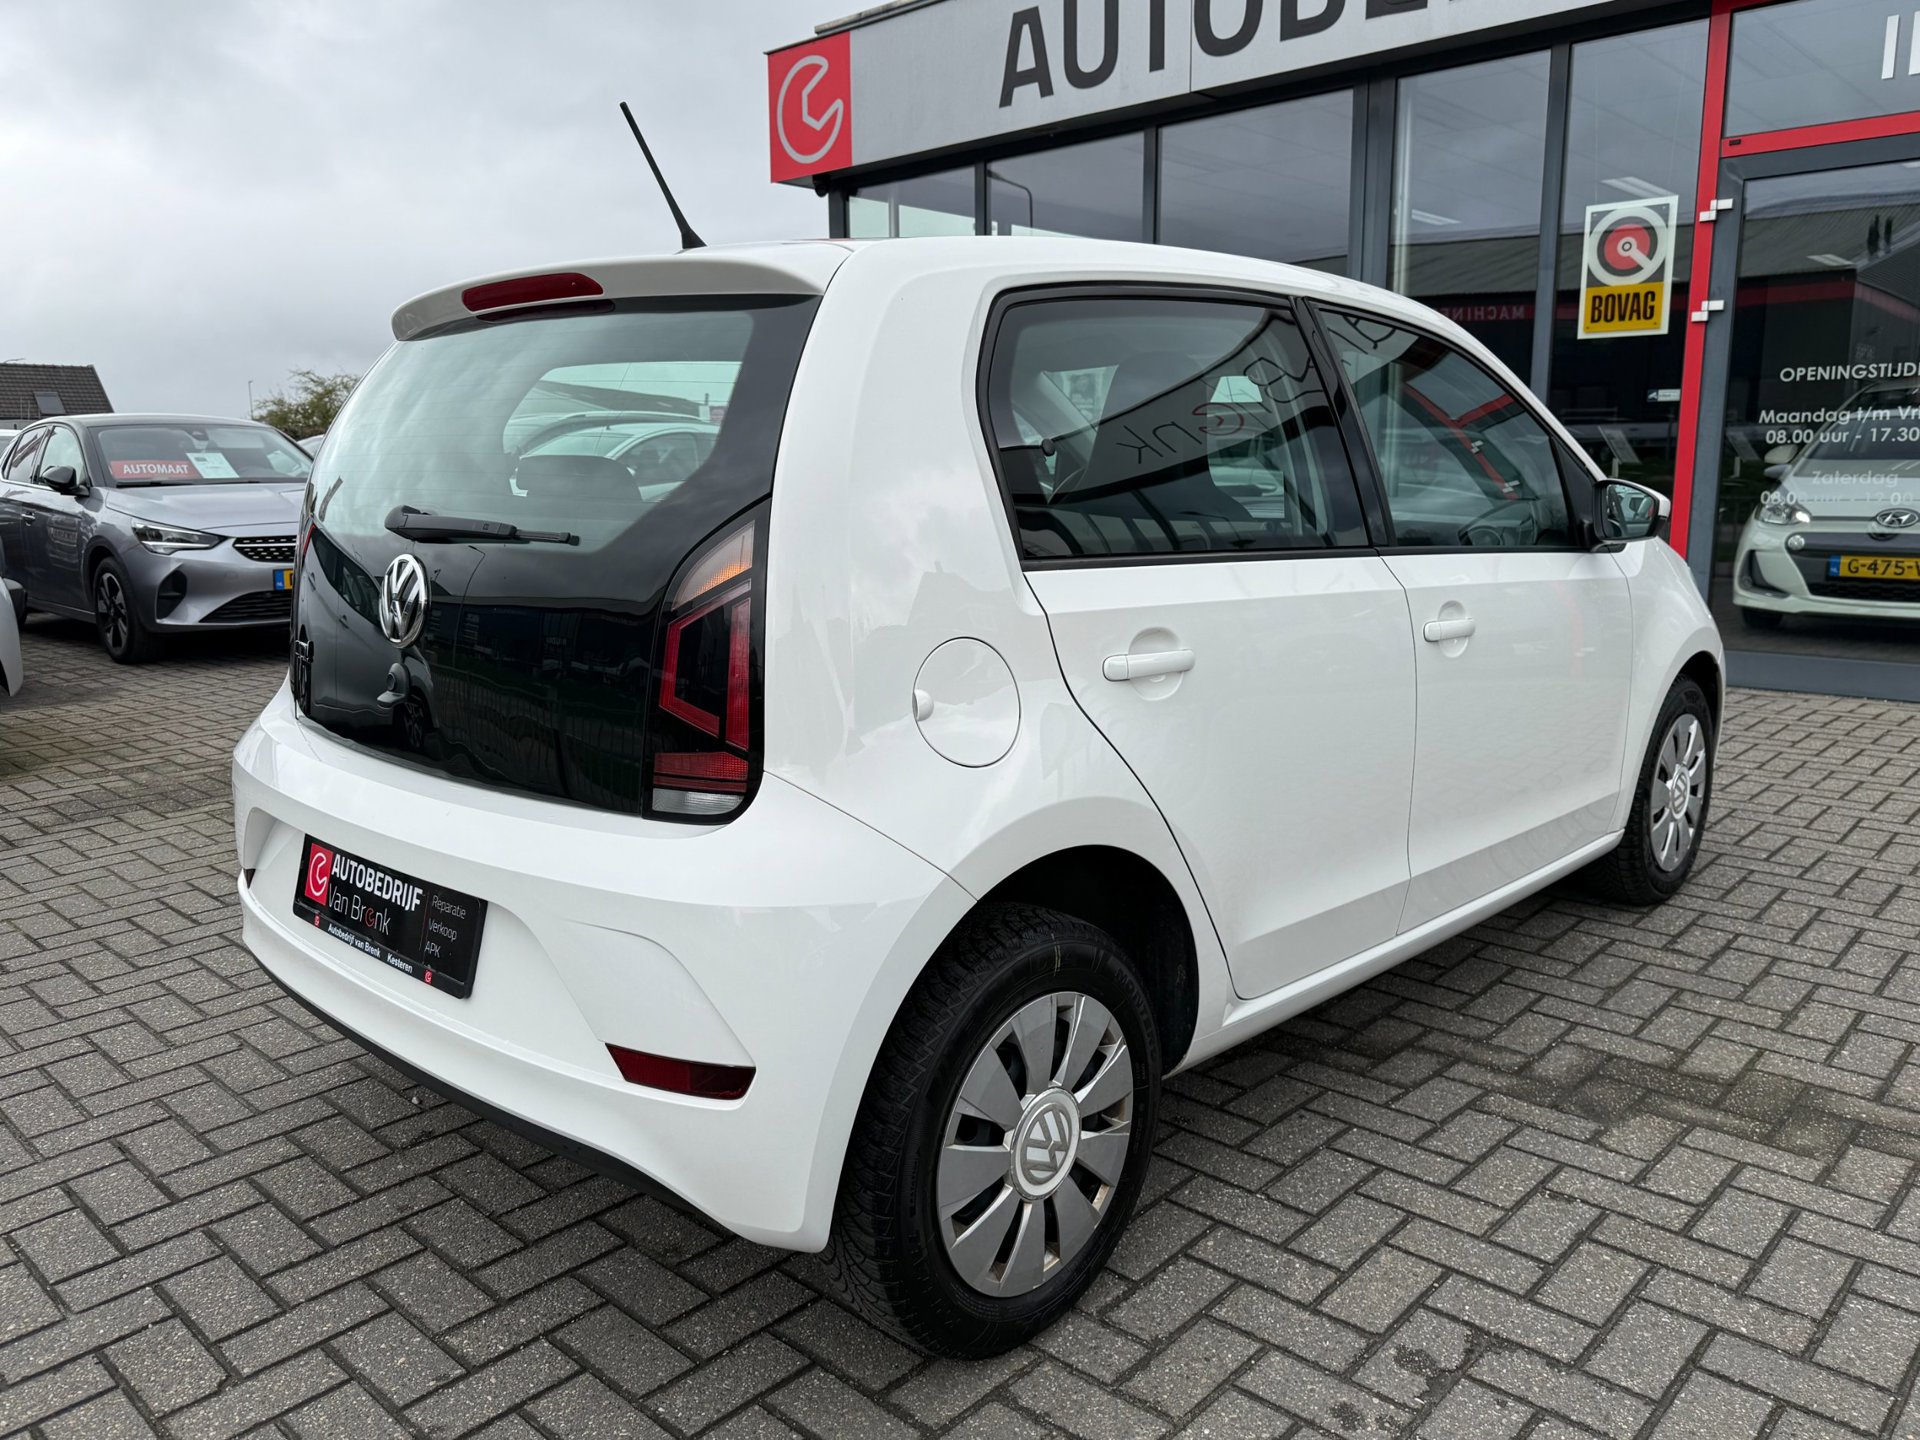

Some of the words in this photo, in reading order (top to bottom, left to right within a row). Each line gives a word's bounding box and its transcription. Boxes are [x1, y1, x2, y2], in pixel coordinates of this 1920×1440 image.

[1590, 290, 1656, 324] BOVAG
[1779, 362, 1920, 382] OPENINGSTIJD
[1758, 408, 1850, 425] Maandag
[1856, 405, 1890, 424] t/m
[1765, 429, 1814, 444] 08.00
[1819, 431, 1849, 443] uur
[1870, 427, 1920, 442] 17.30
[123, 463, 189, 475] AUTOMAAT
[1811, 470, 1899, 488] Zaterdag
[331, 853, 423, 912] AUTOBEDRIJF
[328, 883, 349, 916] Van
[432, 895, 467, 920] Reparatie
[428, 917, 458, 942] Verkoop
[327, 924, 356, 947] Autobedrijf
[354, 936, 365, 951] van
[364, 942, 381, 958] Brenk
[387, 952, 413, 974] Kesteren
[424, 941, 441, 958] APK
